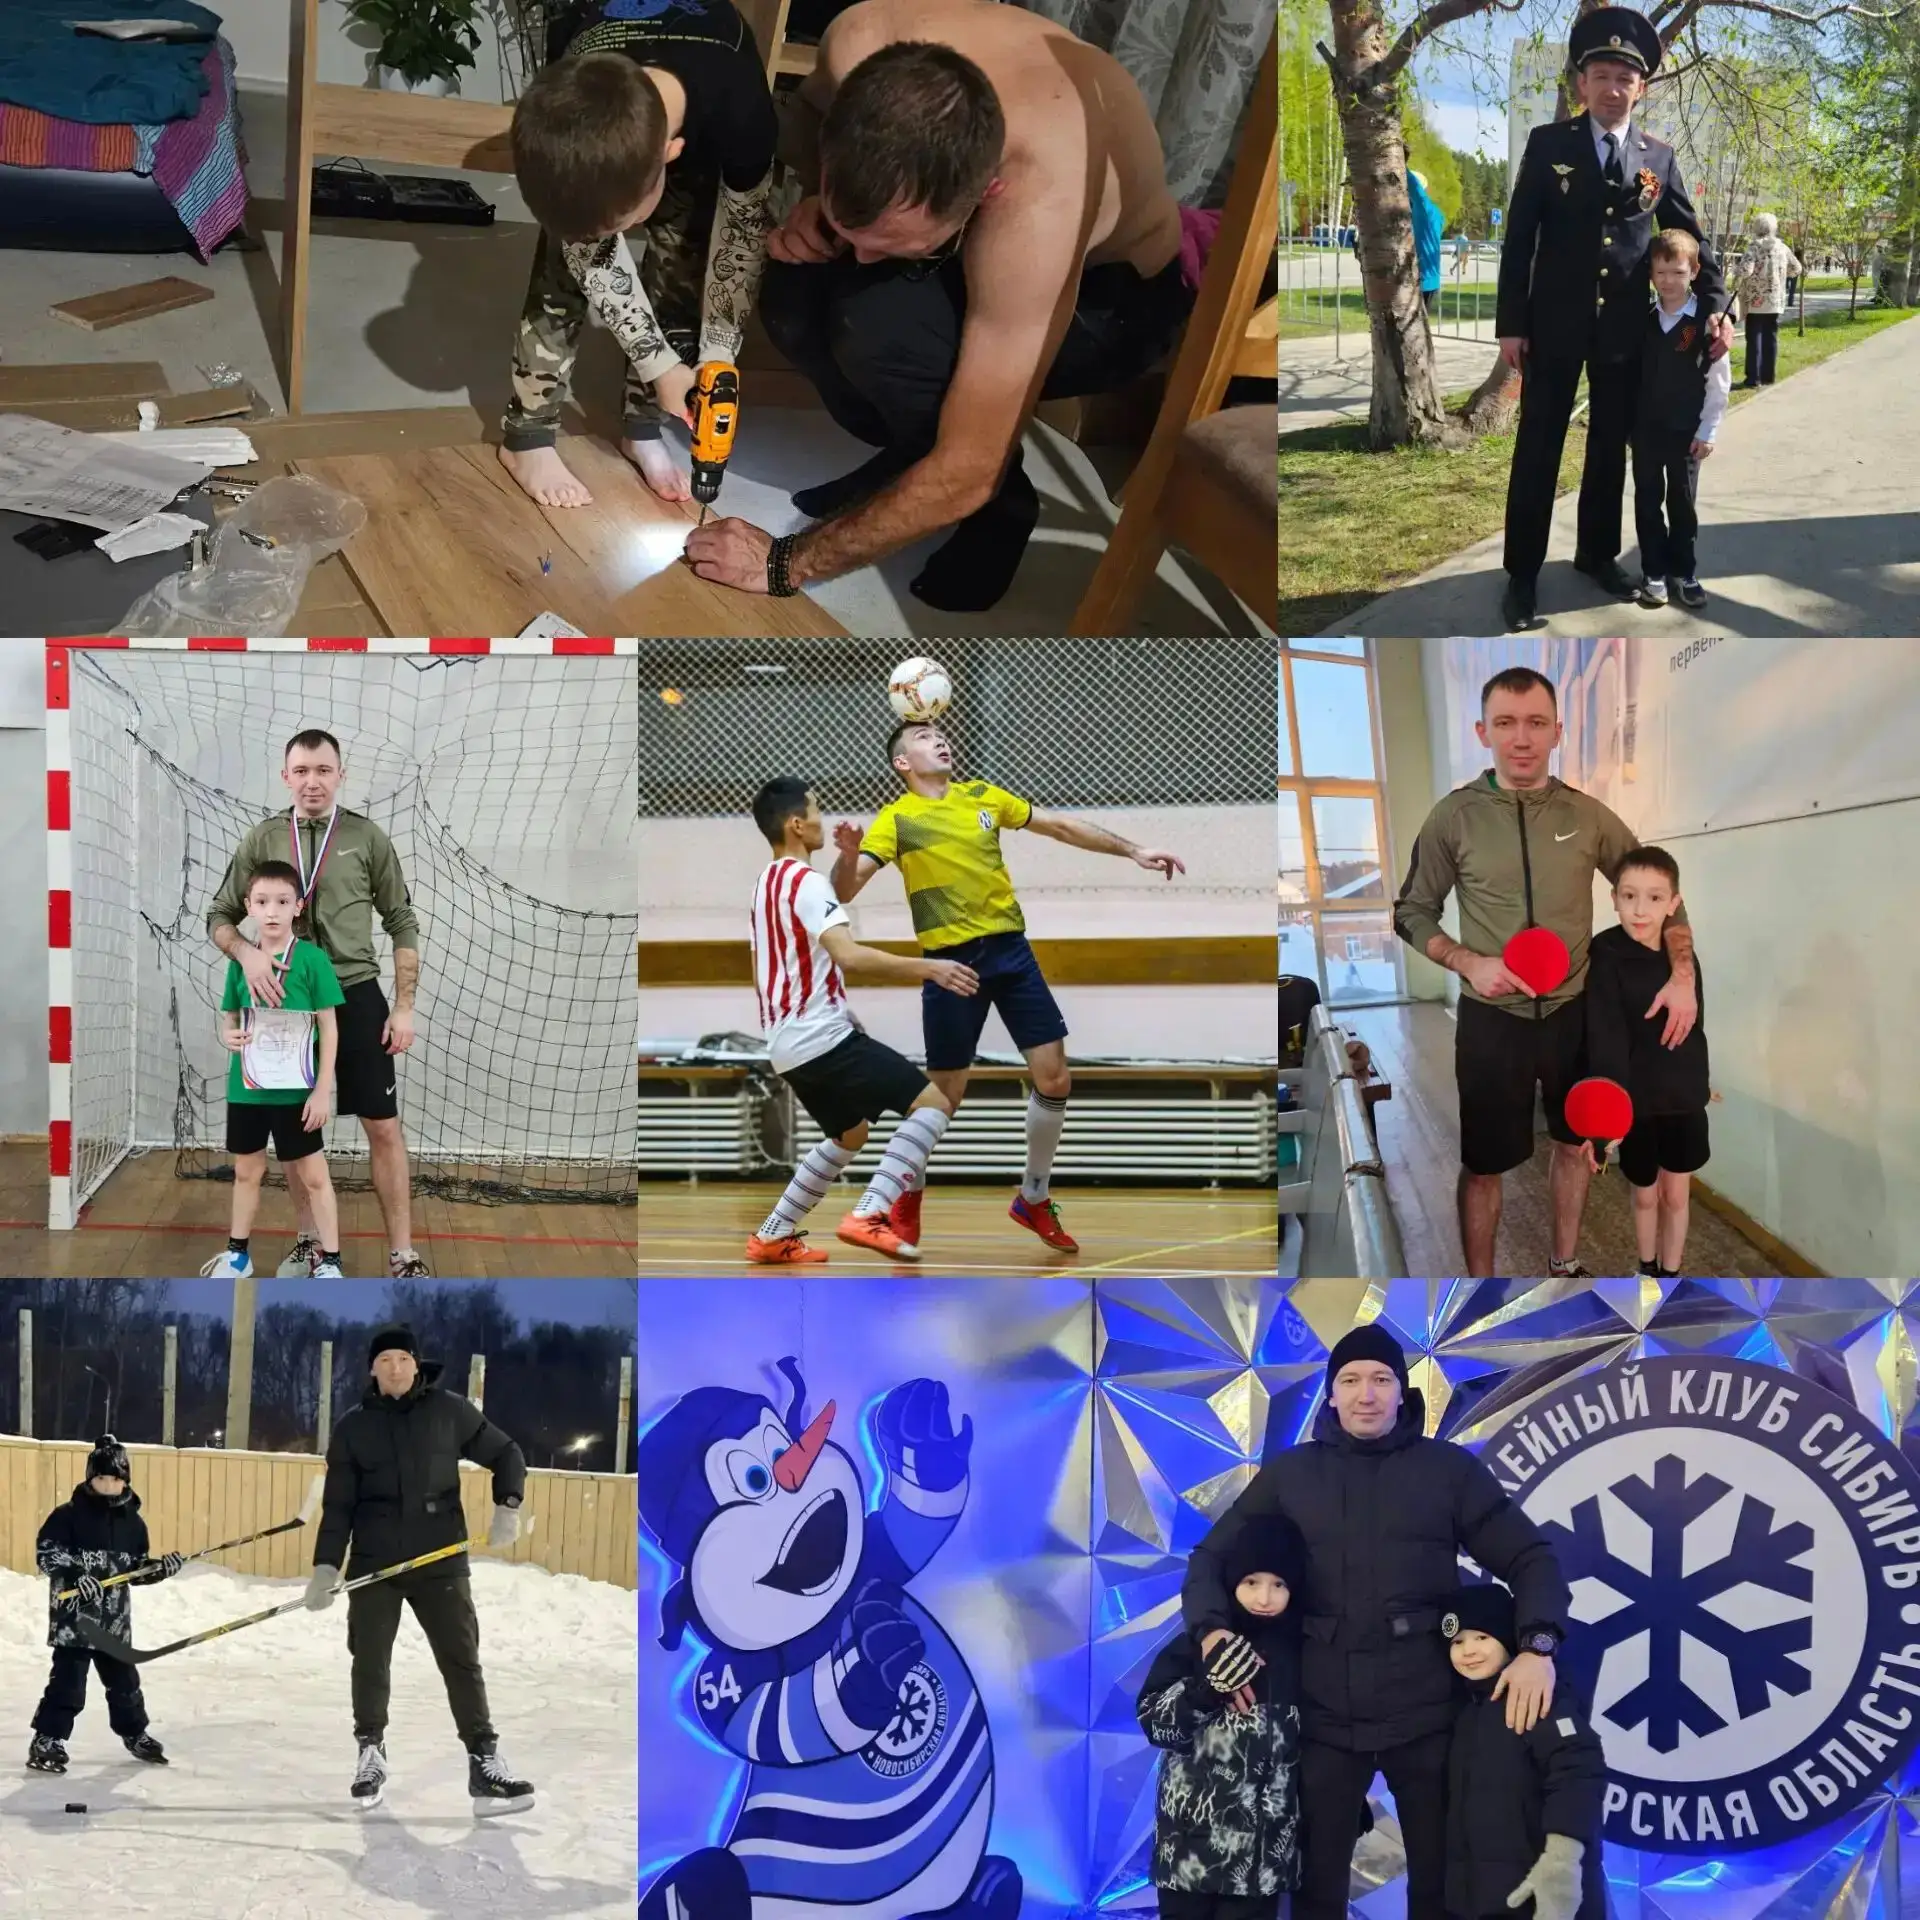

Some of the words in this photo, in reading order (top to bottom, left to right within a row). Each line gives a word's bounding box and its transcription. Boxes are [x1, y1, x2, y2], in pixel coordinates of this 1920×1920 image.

[1669, 1369, 1800, 1434] КЛУБ
[1799, 1412, 1920, 1588] СИБИРЬ
[699, 1663, 742, 1710] 54
[1767, 1644, 1920, 1822] ОБЛАСТЬ
[872, 1728, 942, 1775] НОВОСИБИРСКАЯ
